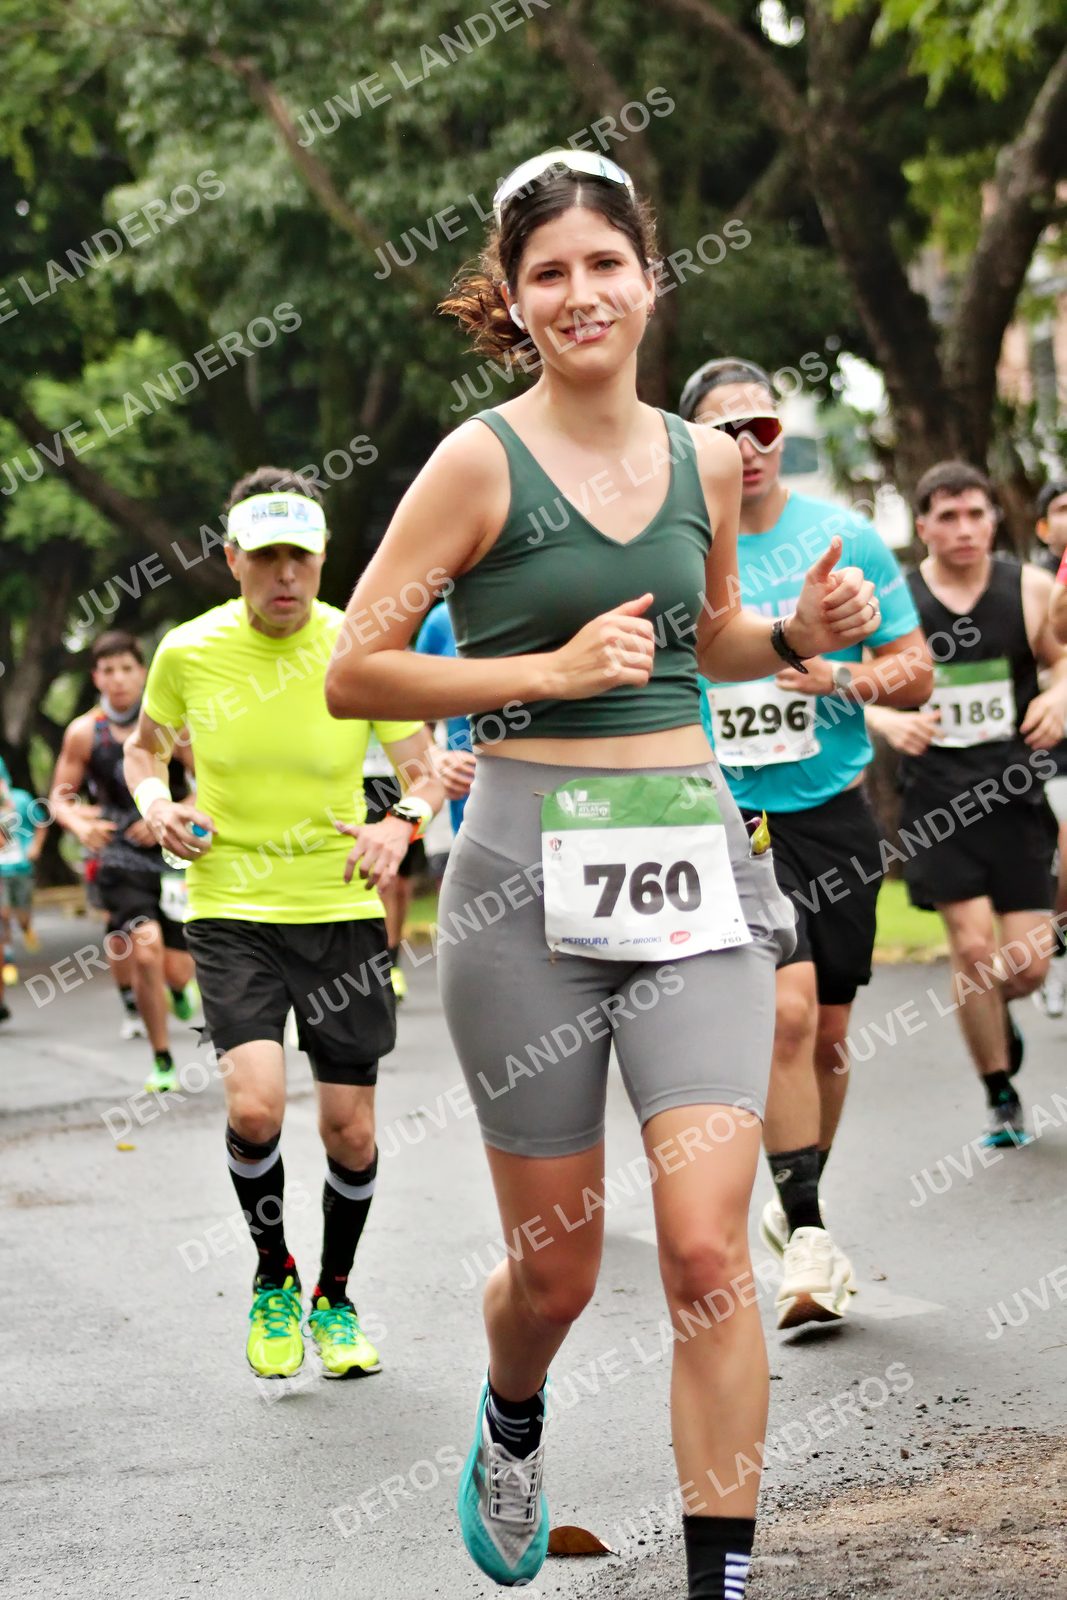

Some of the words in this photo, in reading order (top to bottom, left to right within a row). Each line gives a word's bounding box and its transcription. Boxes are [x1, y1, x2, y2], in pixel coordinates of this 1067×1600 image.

[717, 700, 810, 740] 3296
[583, 860, 702, 918] 760
[561, 936, 610, 946] PERDURA
